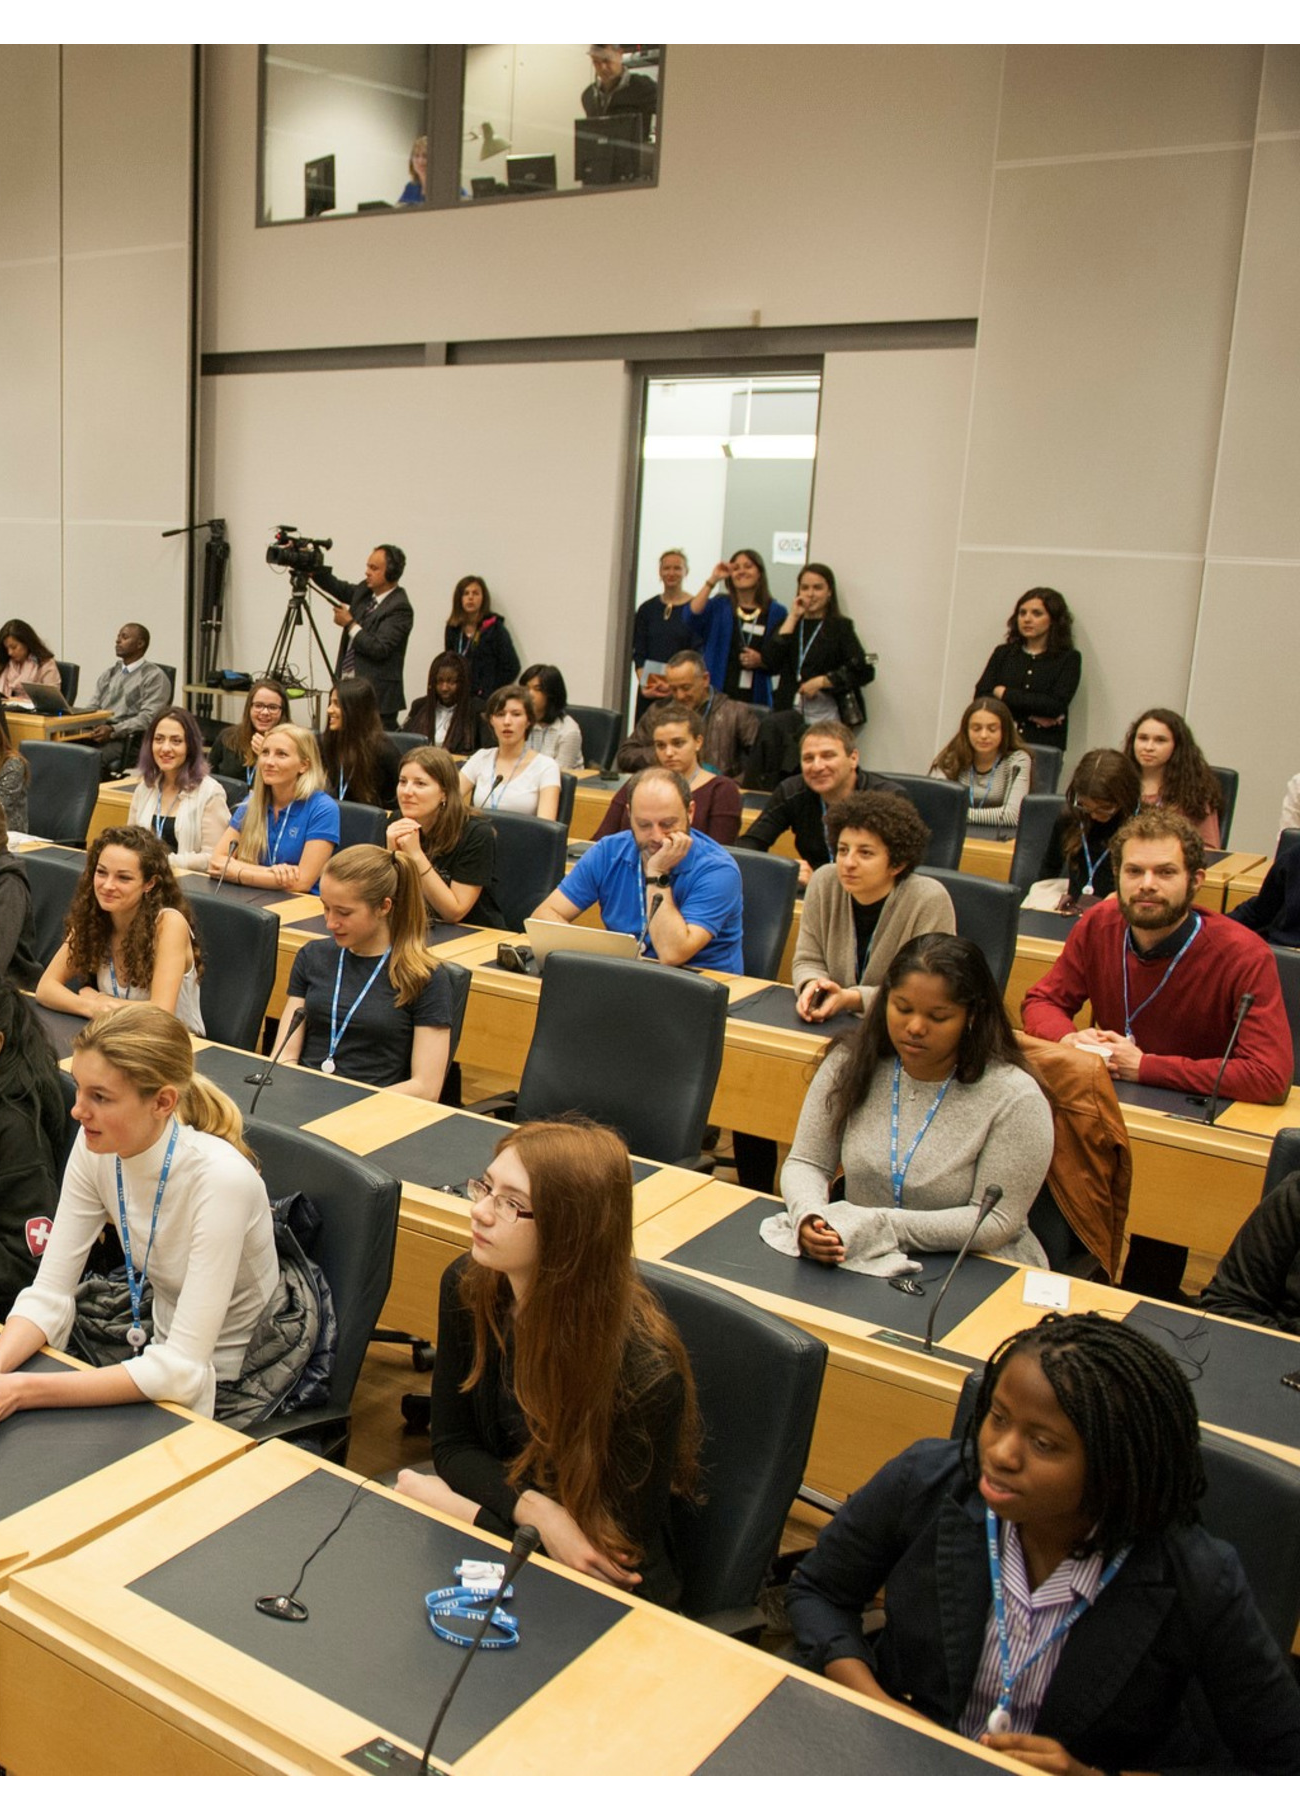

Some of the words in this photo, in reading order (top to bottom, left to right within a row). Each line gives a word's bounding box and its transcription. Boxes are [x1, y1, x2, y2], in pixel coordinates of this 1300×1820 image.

[439, 1588, 455, 1597] ITU
[989, 1539, 999, 1559] ITU
[994, 1579, 1003, 1599] ITU
[999, 1620, 1008, 1640] ITU
[468, 1612, 484, 1620] ITU
